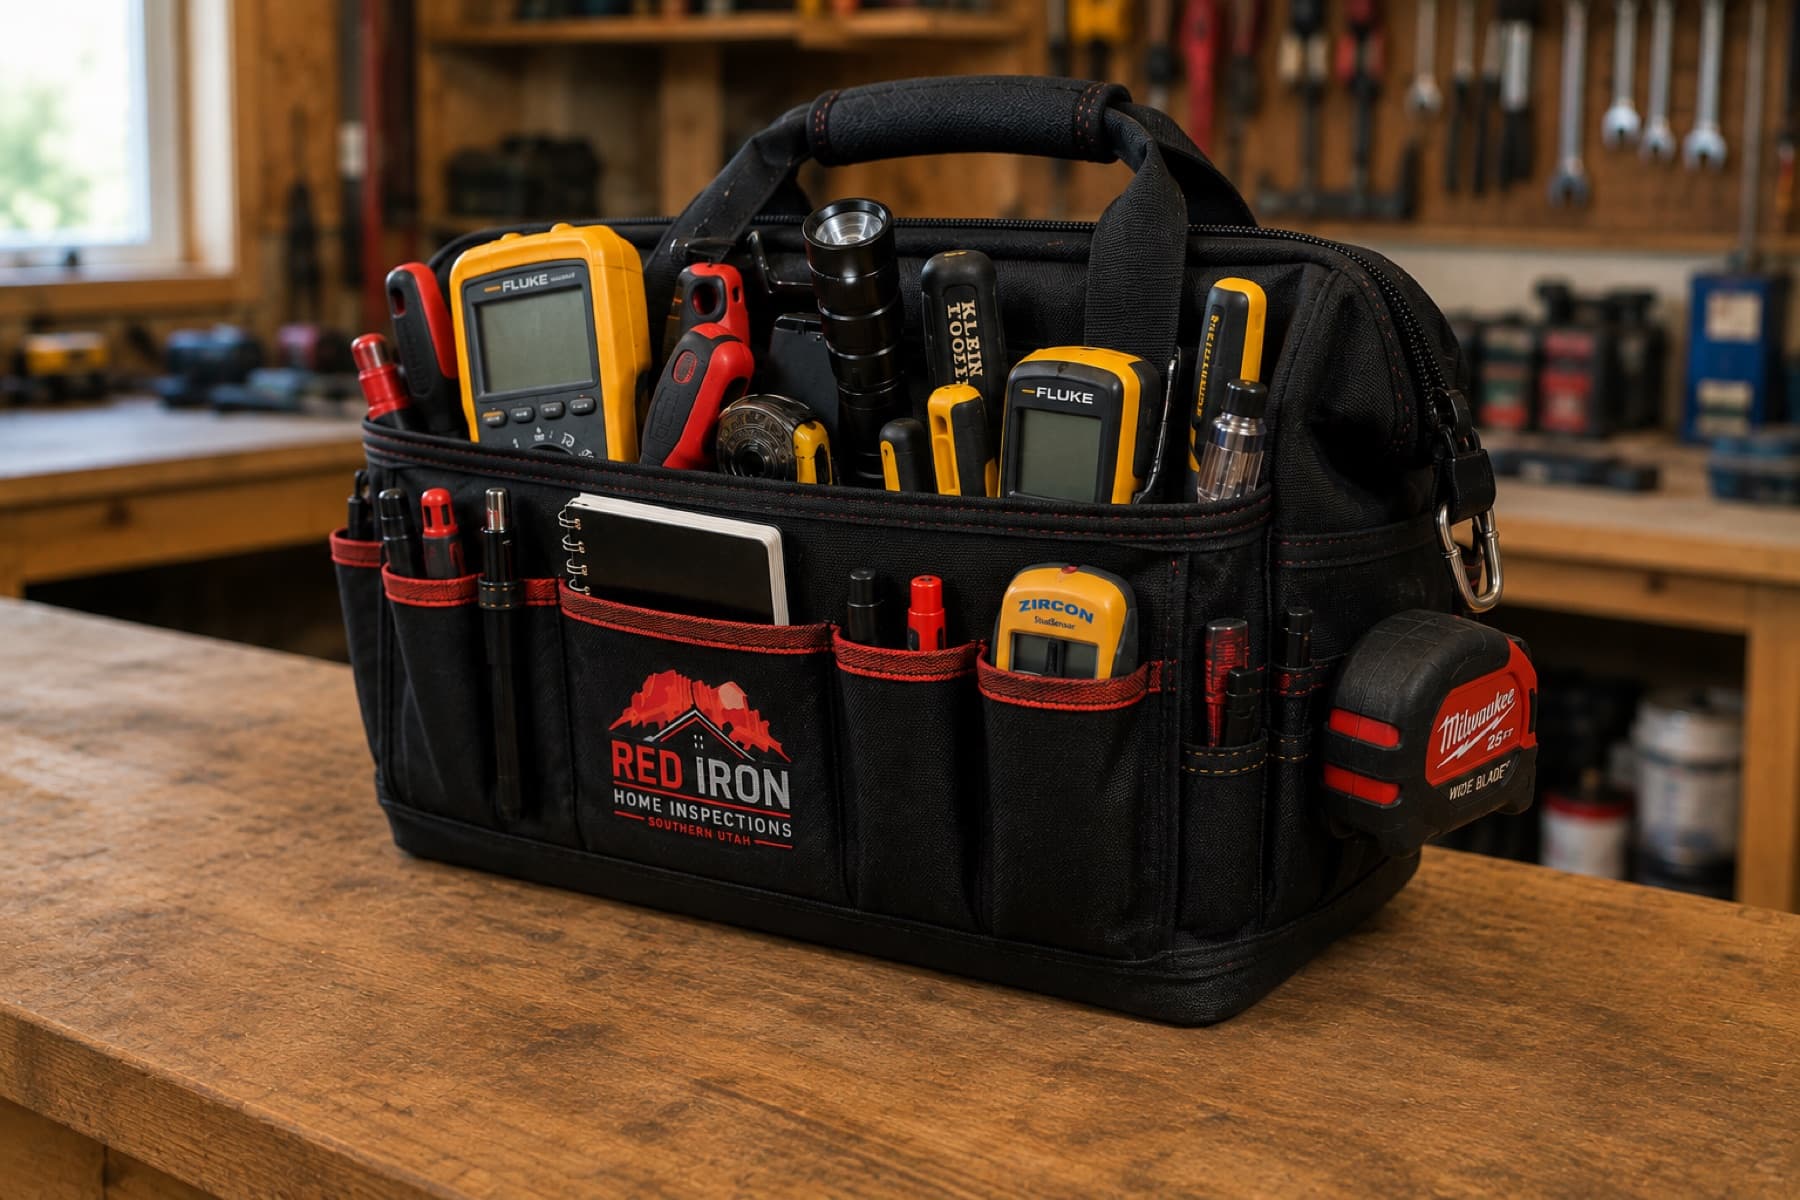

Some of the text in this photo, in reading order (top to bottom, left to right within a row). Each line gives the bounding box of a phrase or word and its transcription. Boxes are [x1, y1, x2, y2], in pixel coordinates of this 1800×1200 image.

[502, 273, 549, 293] FLUKE
[961, 299, 983, 377] KLEIN
[1036, 386, 1094, 405] FLUKE
[1018, 598, 1094, 624] ZIRCON
[1437, 688, 1515, 755] Milwaukee
[611, 739, 791, 810] RED IRON
[613, 788, 792, 838] HOME INSPECTIONS
[648, 815, 751, 846] SOUTHERN UTAH
